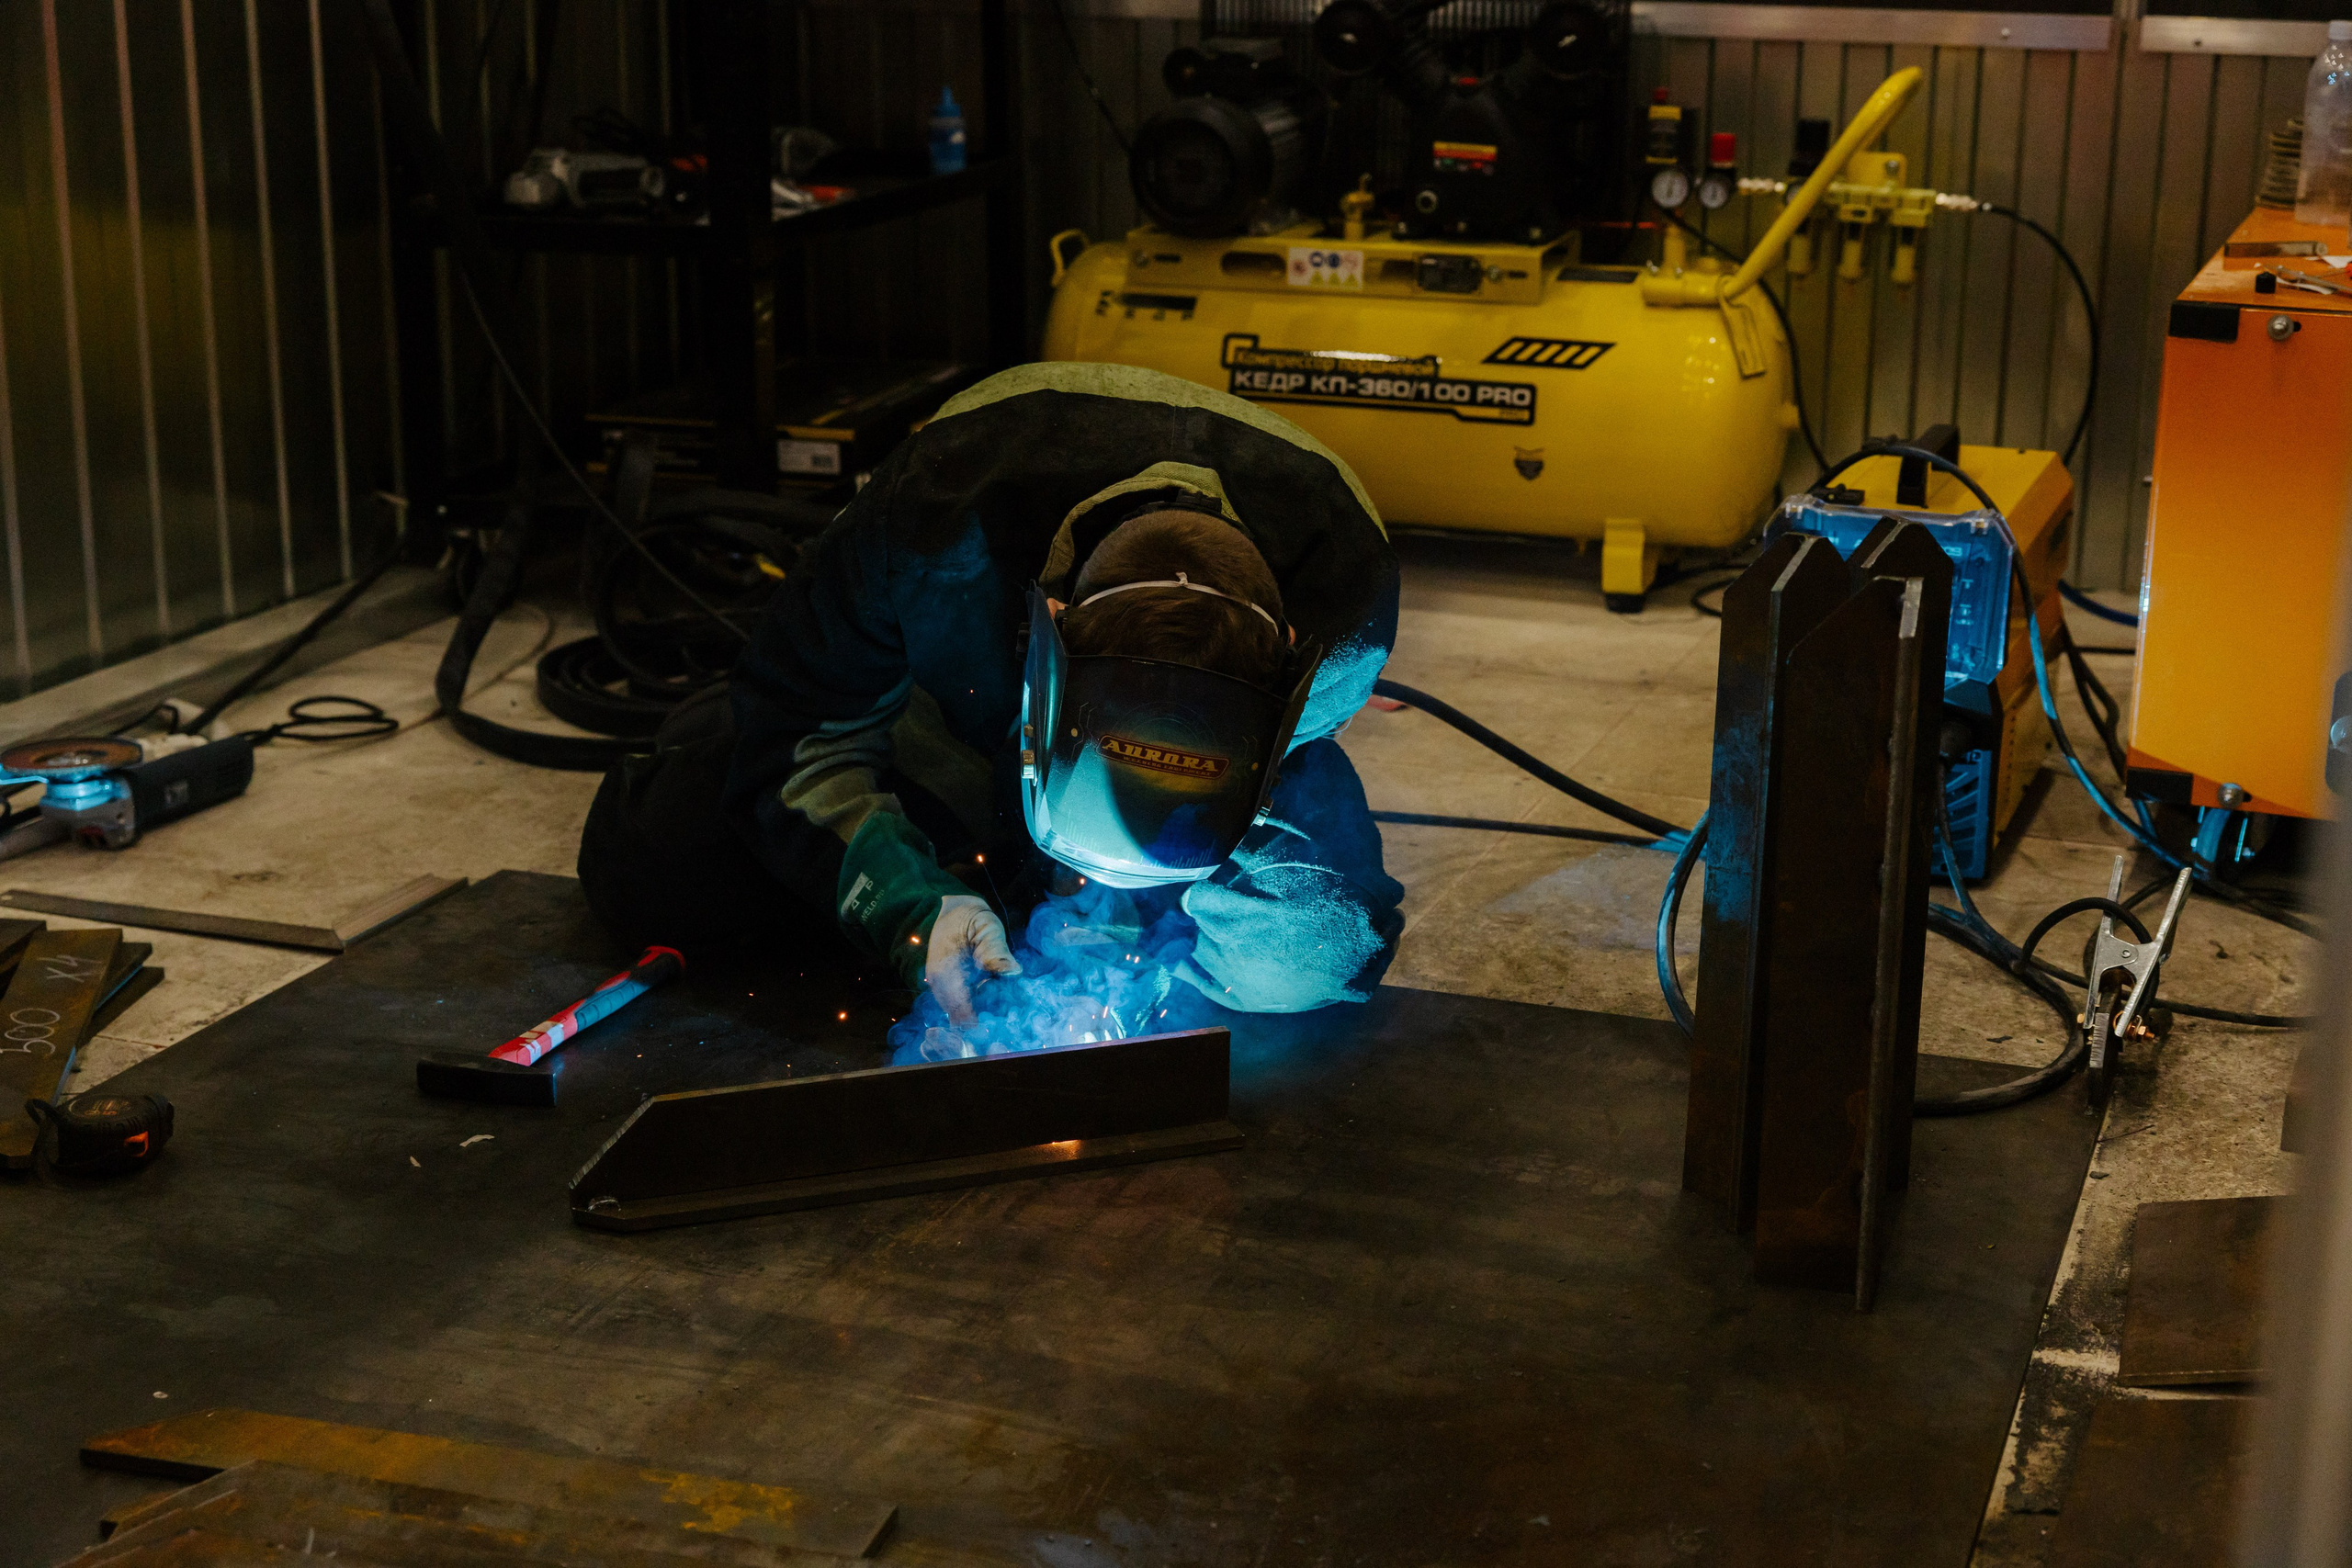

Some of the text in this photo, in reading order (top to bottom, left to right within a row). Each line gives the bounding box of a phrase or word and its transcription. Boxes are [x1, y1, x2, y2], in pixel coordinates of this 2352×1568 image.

[1234, 370, 1306, 392] КЕДР
[1476, 385, 1532, 407] PRO
[1102, 739, 1219, 773] AURORA
